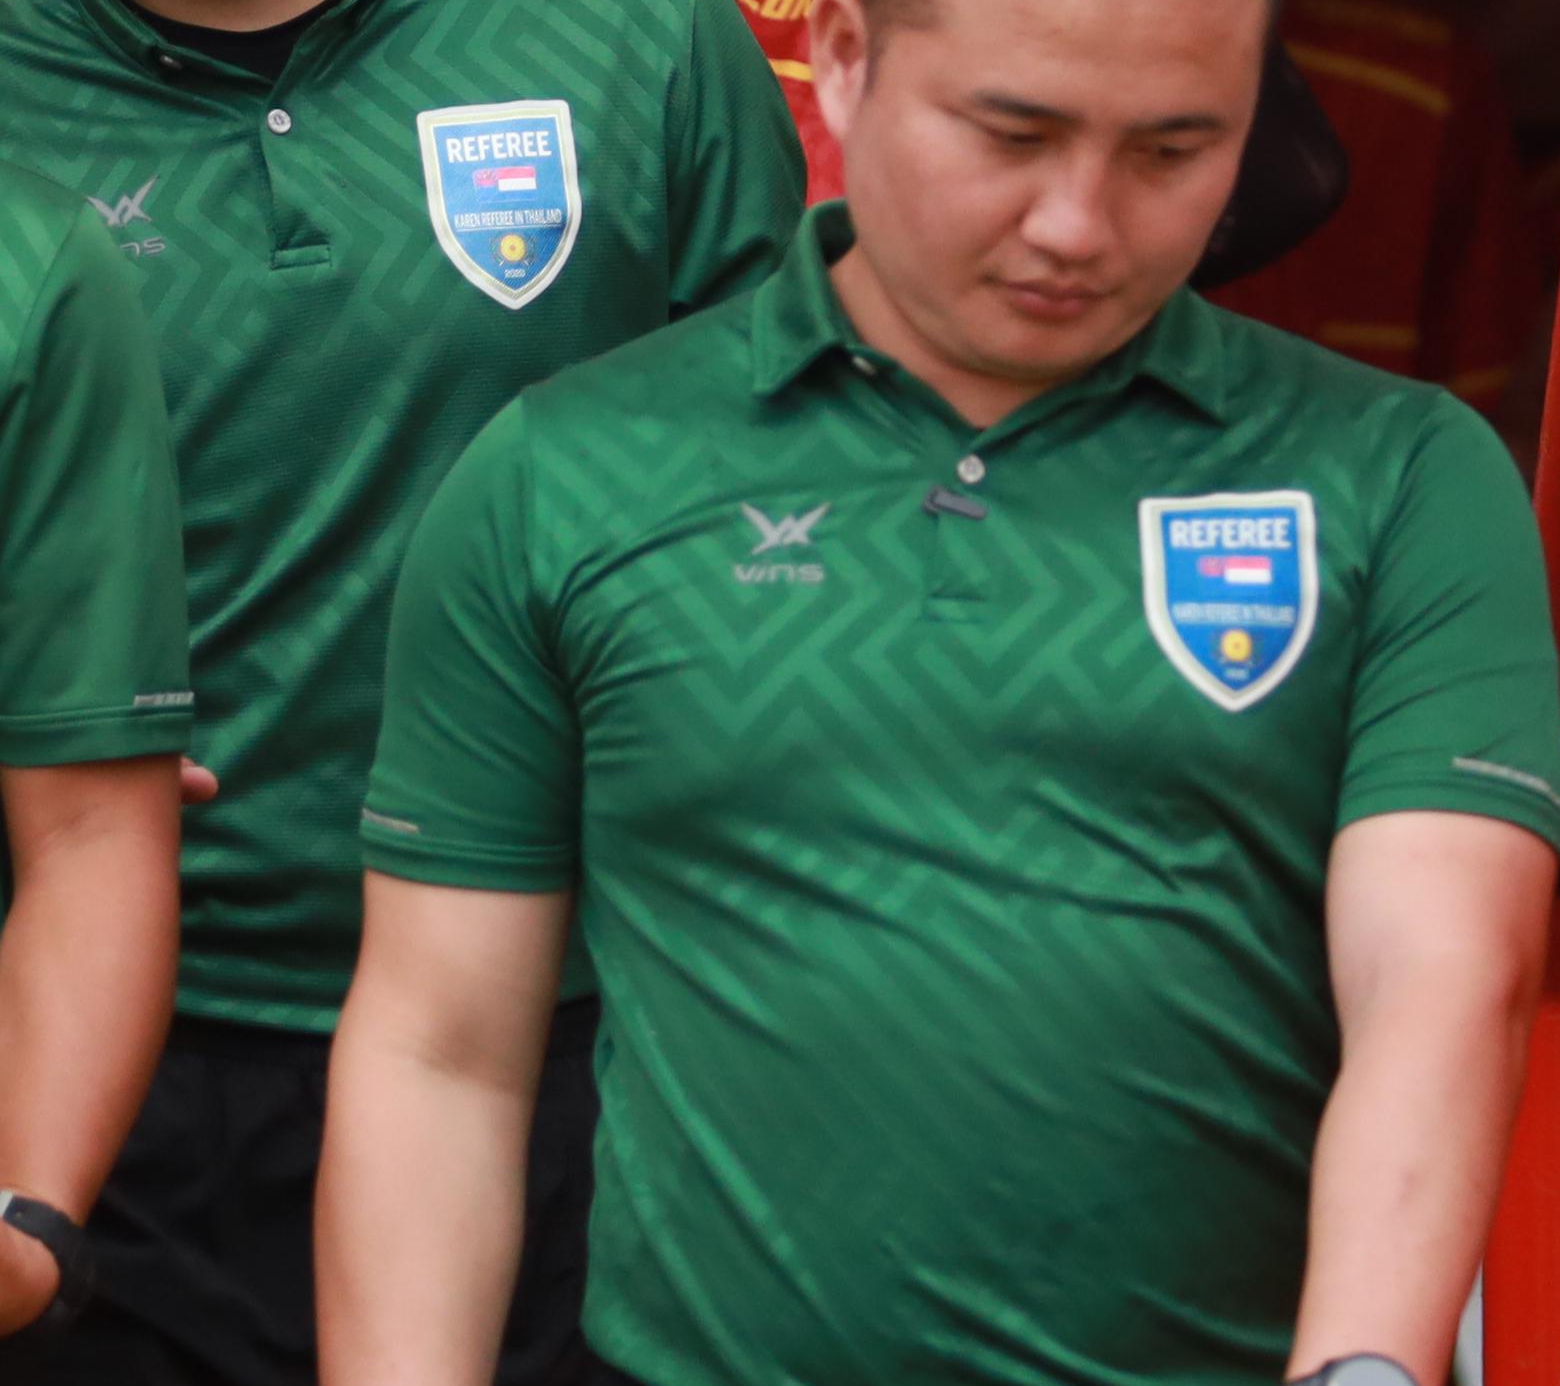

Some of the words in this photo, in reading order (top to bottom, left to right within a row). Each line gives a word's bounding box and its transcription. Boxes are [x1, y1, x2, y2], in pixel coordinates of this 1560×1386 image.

[446, 130, 552, 163] REFEREE
[481, 210, 513, 227] REFEREE
[514, 209, 523, 224] IN
[523, 208, 562, 224] THAILAND
[119, 236, 166, 258] ns
[1169, 517, 1292, 550] REFEREE
